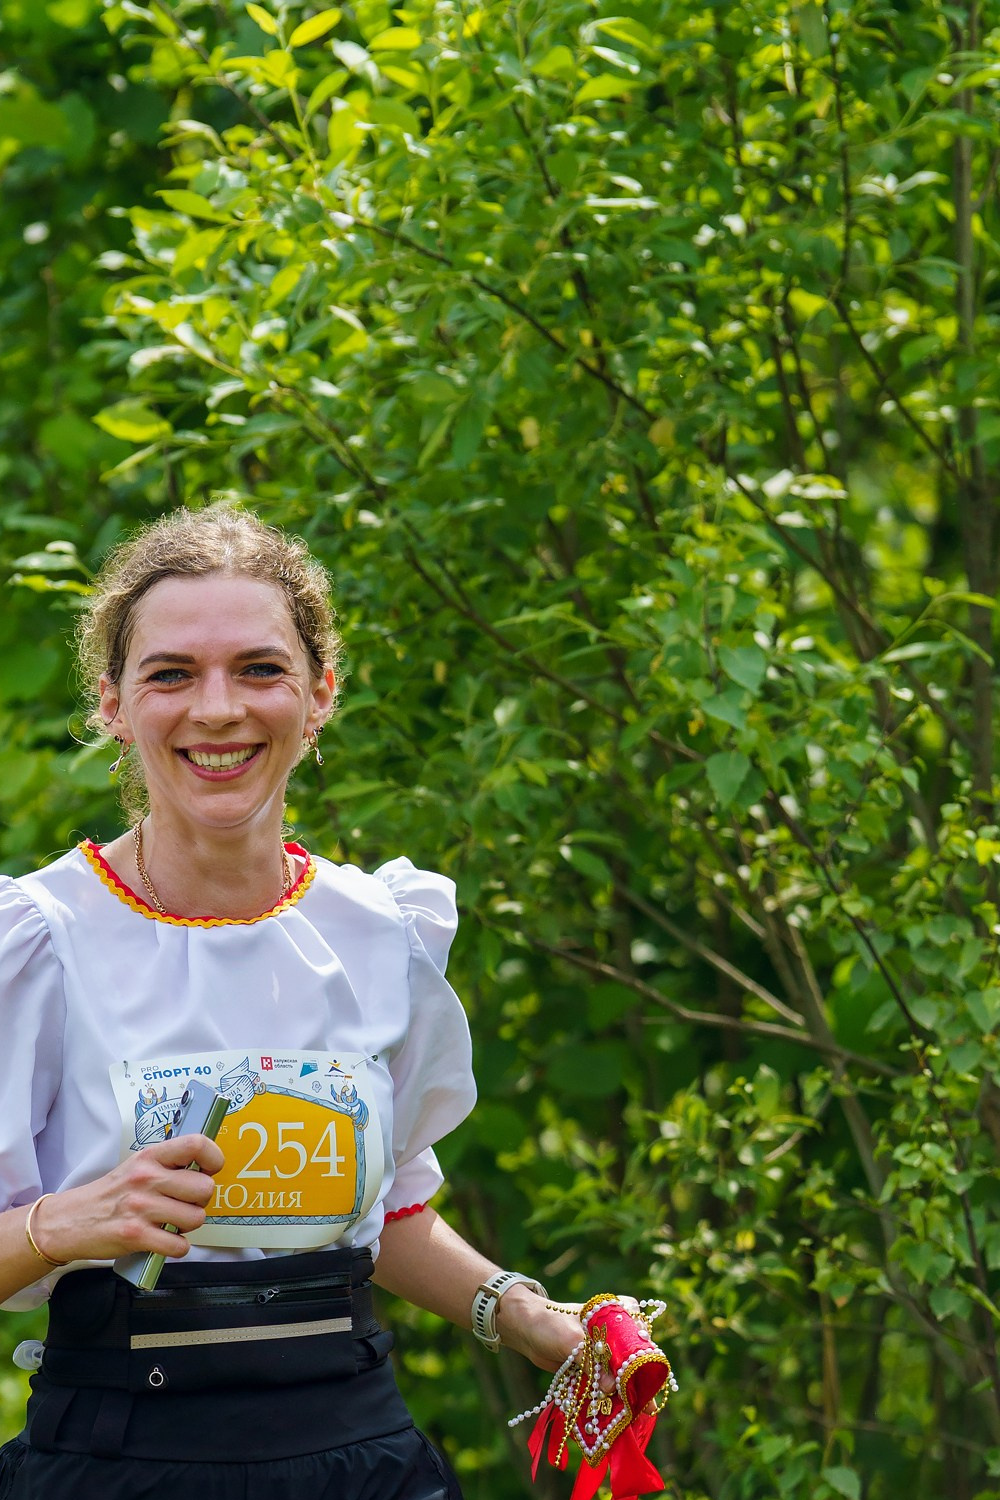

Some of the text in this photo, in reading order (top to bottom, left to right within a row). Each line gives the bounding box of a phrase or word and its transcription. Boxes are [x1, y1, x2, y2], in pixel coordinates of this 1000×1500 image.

[140, 1065, 159, 1074] PRO
[143, 1065, 212, 1081] СПОРТ 40
[236, 1121, 346, 1179] 254
[212, 1183, 303, 1209] Юлия
